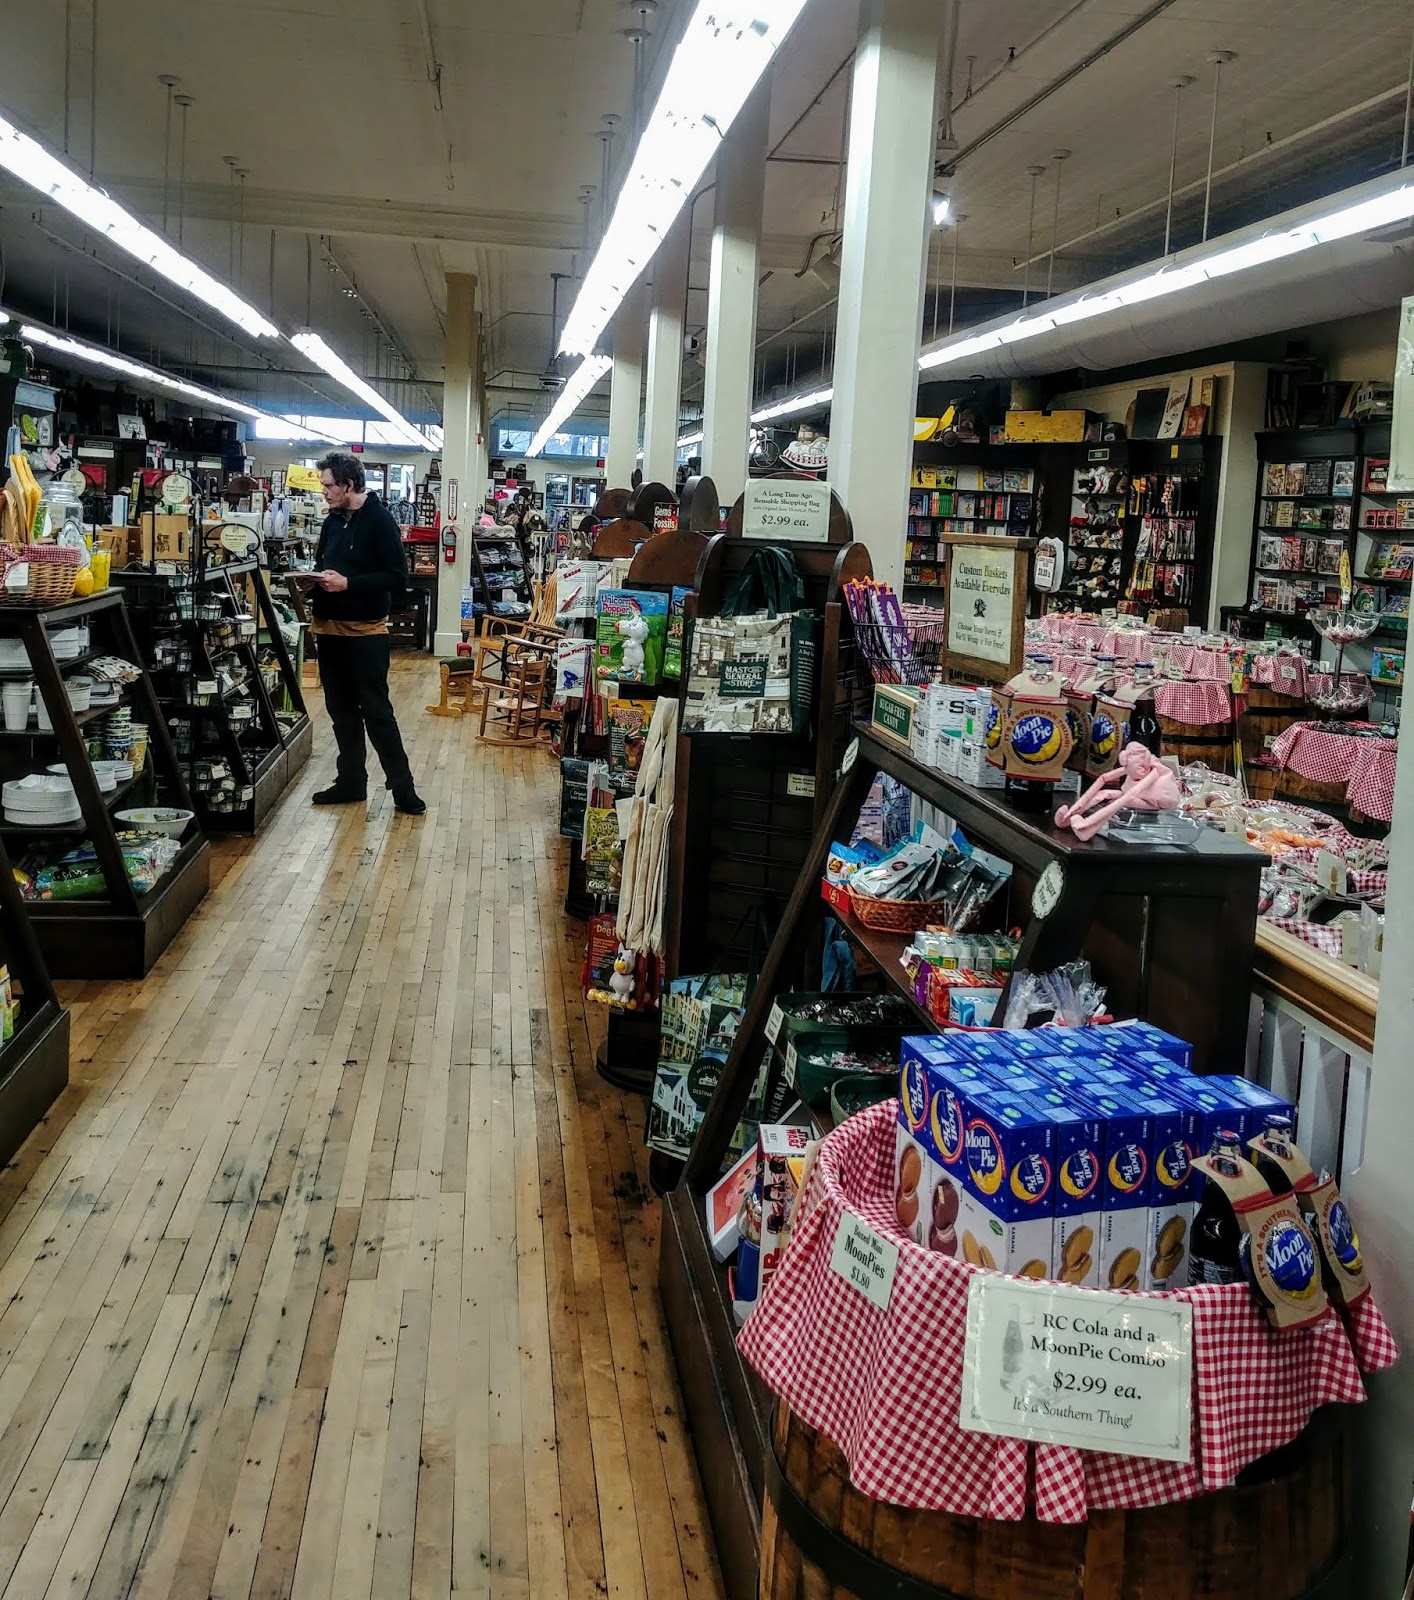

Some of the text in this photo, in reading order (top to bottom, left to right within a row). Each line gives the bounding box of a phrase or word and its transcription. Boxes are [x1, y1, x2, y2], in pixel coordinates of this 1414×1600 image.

[654, 506, 672, 517] Gems
[761, 514, 790, 526] $2.99
[653, 517, 675, 529] Fossils
[959, 562, 1008, 580] Custom Baskets
[953, 578, 1011, 597] Available Everyday
[601, 595, 632, 605] Unicorn
[602, 603, 630, 615] Popper
[725, 665, 748, 673] MAST
[730, 679, 756, 688] STORE
[879, 698, 906, 721] SUGAR-FREE
[1014, 709, 1058, 721] SOUTHERN
[883, 713, 899, 730] CANDY
[1011, 716, 1042, 742] Moon
[1032, 724, 1052, 746] Pie
[596, 925, 612, 936] Dog
[693, 1089, 712, 1097] DESTINA
[913, 1058, 924, 1110] Moon
[945, 1086, 958, 1142] Moon
[941, 1117, 951, 1147] Pie
[965, 1130, 990, 1148] Moon
[980, 1149, 996, 1167] Pie
[1078, 1148, 1093, 1179] Moon
[1126, 1143, 1141, 1175] Moon
[1173, 1140, 1187, 1170] Moon
[1028, 1153, 1045, 1185] Moon
[1073, 1170, 1085, 1188] Pie
[1121, 1165, 1133, 1183] Pie
[1168, 1161, 1179, 1179] Pie
[1024, 1174, 1037, 1194] Pie
[1259, 1209, 1300, 1240] SOUTHERN
[853, 1224, 884, 1255] Boxed Mini
[844, 1234, 885, 1279] MoonPies
[1265, 1232, 1304, 1273] Moon
[1297, 1248, 1314, 1277] Pie
[850, 1265, 870, 1289] $1.80
[1042, 1313, 1156, 1343] RC Cola and a
[1031, 1335, 1166, 1368] MoonPie Combo
[1052, 1369, 1142, 1400] $2.99 ea.
[1013, 1396, 1133, 1429] It's a Southern Thing!
